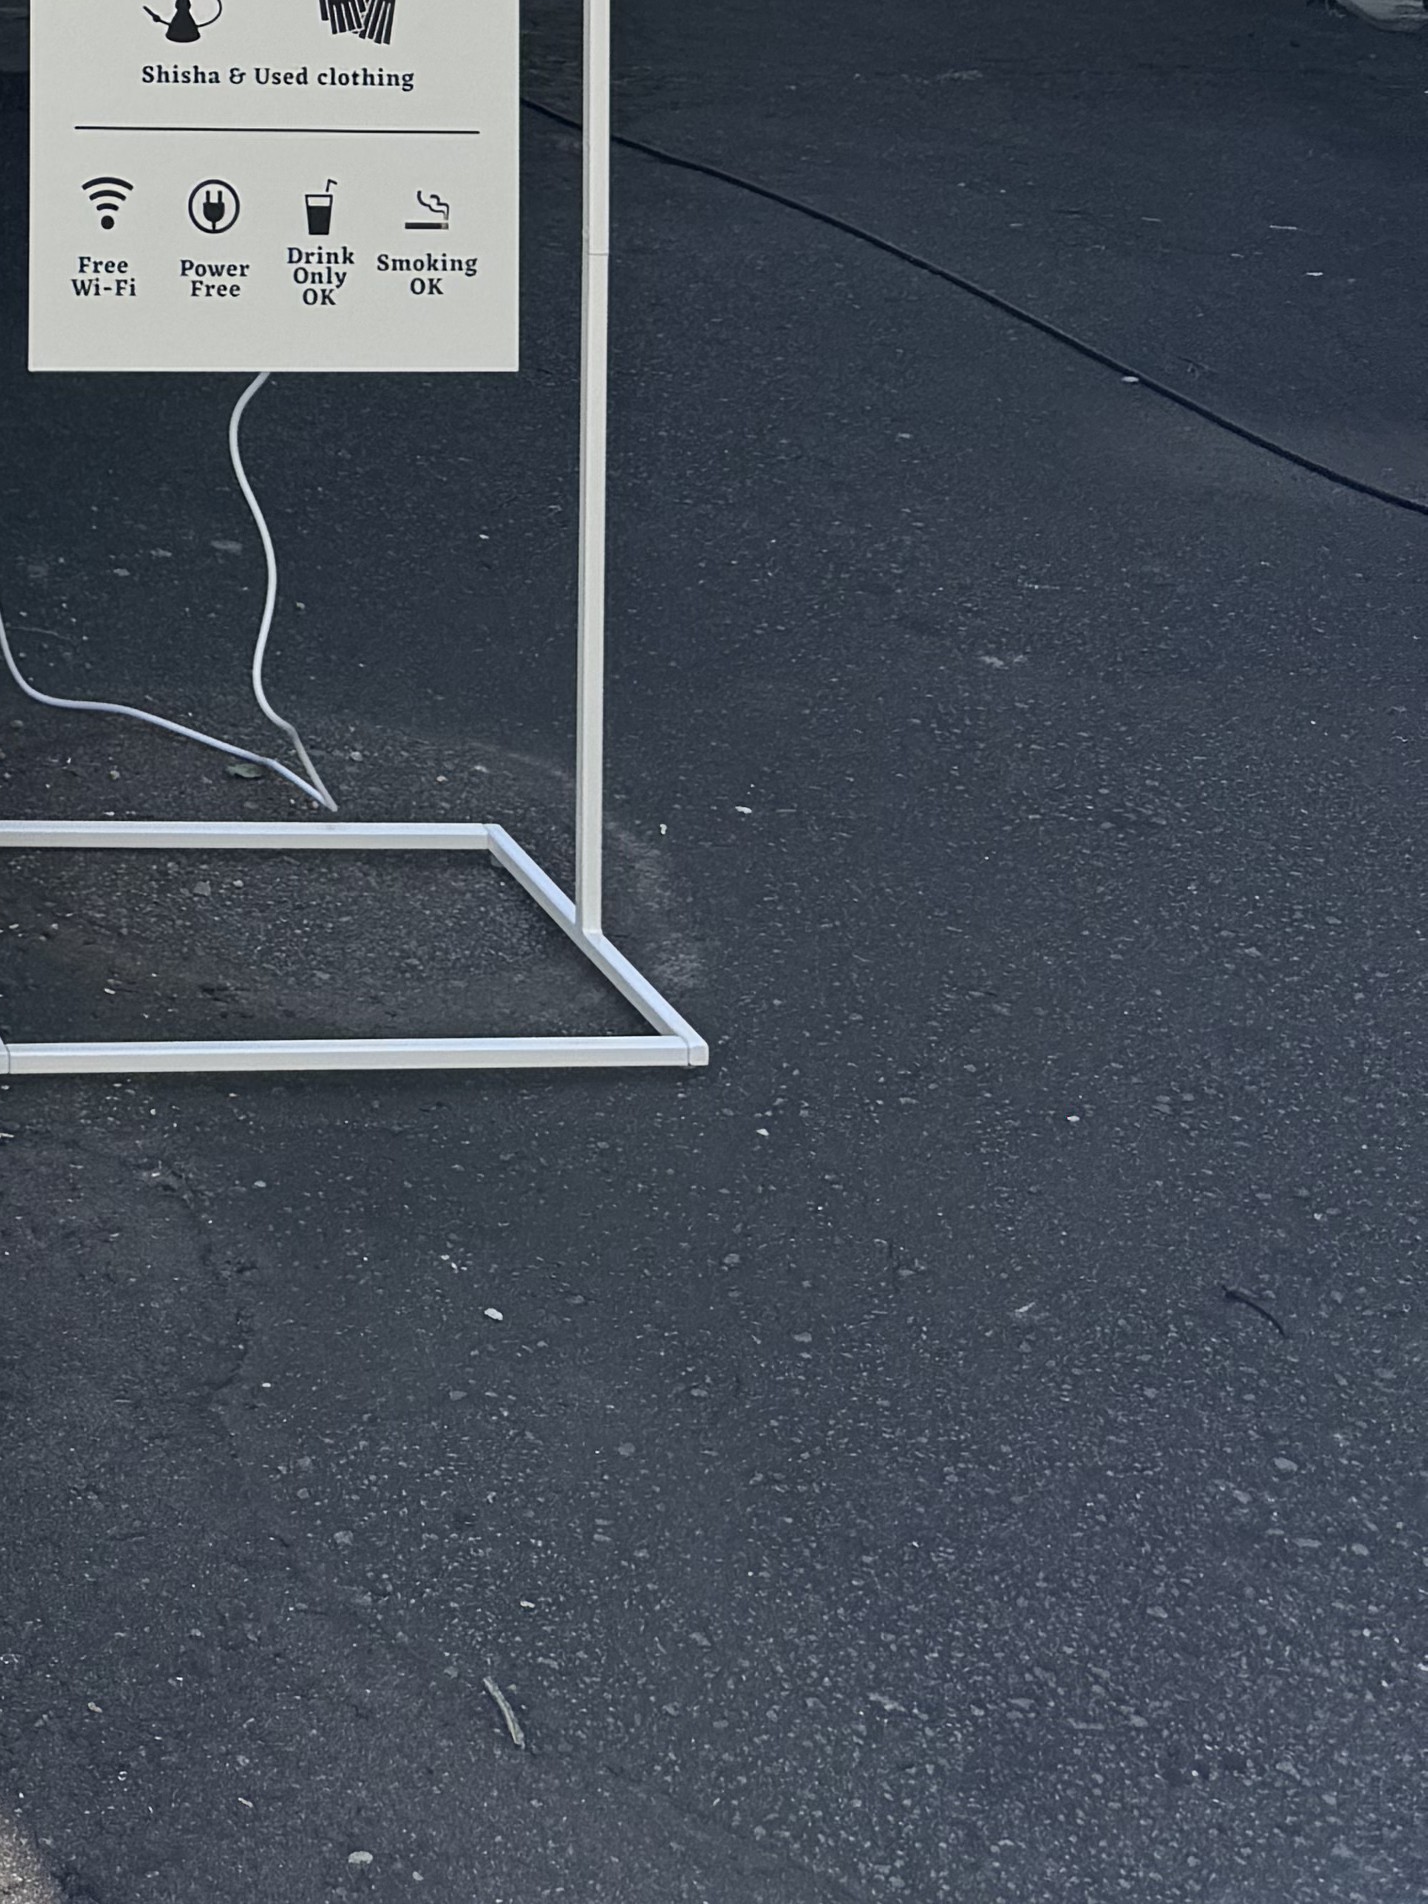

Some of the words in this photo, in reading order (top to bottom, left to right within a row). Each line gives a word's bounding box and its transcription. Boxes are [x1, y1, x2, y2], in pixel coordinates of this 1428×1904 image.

[141, 64, 221, 85] Shisha
[229, 67, 247, 85] &
[254, 66, 309, 86] Used
[317, 67, 415, 92] clothing
[78, 256, 129, 274] Free
[287, 246, 355, 265] Drink
[376, 252, 478, 276] Smoking
[180, 259, 251, 278] Power
[293, 266, 348, 289] Only
[71, 278, 137, 297] Wi-Fi
[190, 279, 241, 298] Free
[410, 277, 444, 296] OK
[302, 287, 337, 306] OK
